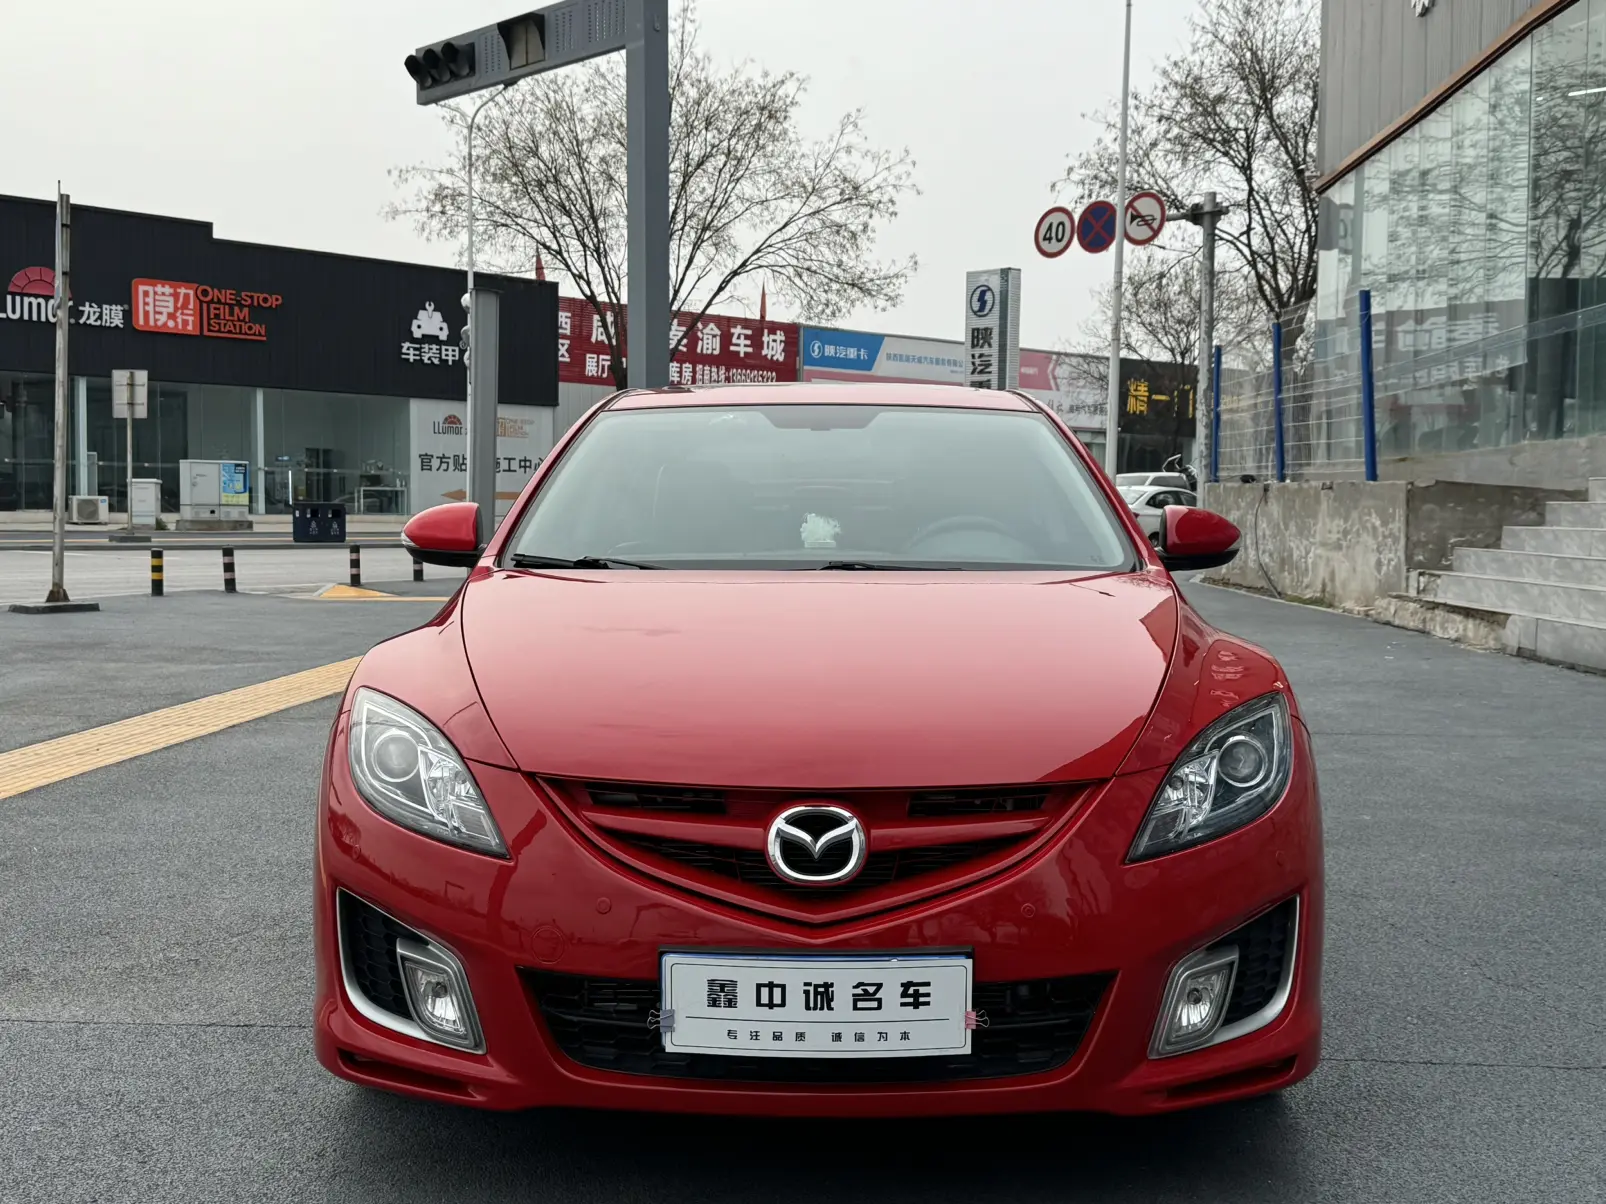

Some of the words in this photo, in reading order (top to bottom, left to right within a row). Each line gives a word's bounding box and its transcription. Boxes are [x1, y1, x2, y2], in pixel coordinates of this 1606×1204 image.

[1042, 221, 1066, 244] 40
[197, 285, 283, 309] ONE-STOP
[79, 302, 124, 328] 龙膜
[210, 304, 249, 322] FILM
[209, 319, 266, 336] STATION
[401, 341, 459, 365] 车装甲
[824, 344, 869, 360] 陕汽重卡
[706, 979, 932, 1012] 鑫中诚名车
[727, 1029, 807, 1043] 专注品质
[831, 1031, 911, 1043] 诚信为本
